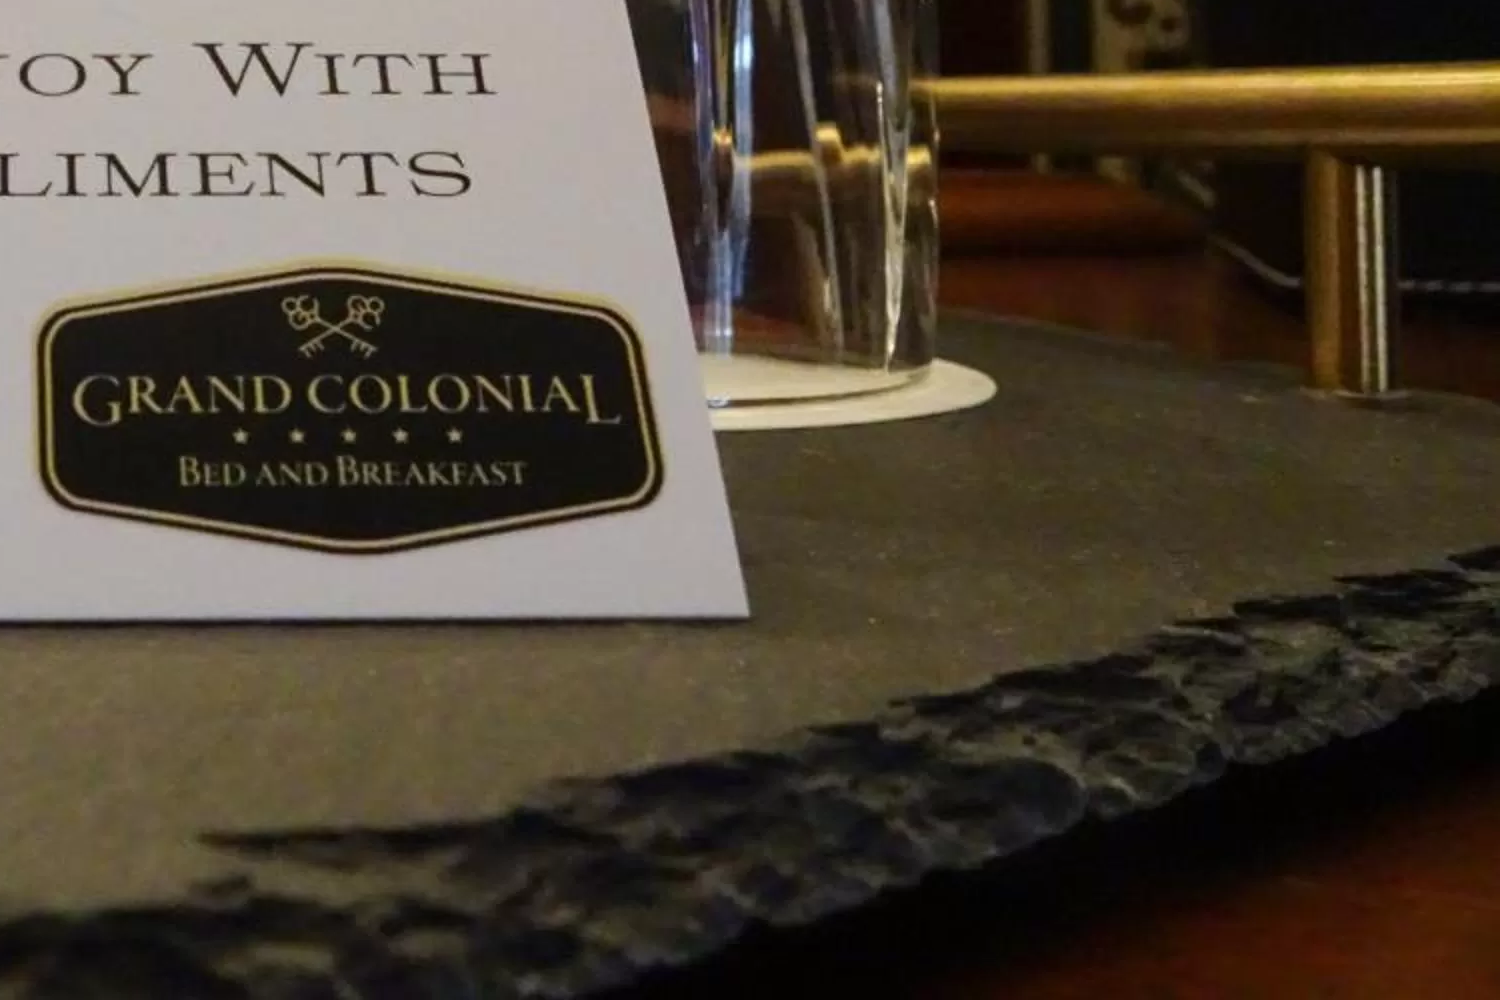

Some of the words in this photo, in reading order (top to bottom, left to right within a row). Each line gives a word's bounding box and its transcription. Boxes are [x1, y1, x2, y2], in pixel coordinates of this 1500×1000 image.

[193, 43, 498, 98] WITH
[73, 375, 293, 426] GRAND
[307, 374, 622, 426] COLONIAL
[179, 455, 248, 488] BED
[256, 460, 330, 487] AND
[336, 455, 528, 488] BREAKFAST
